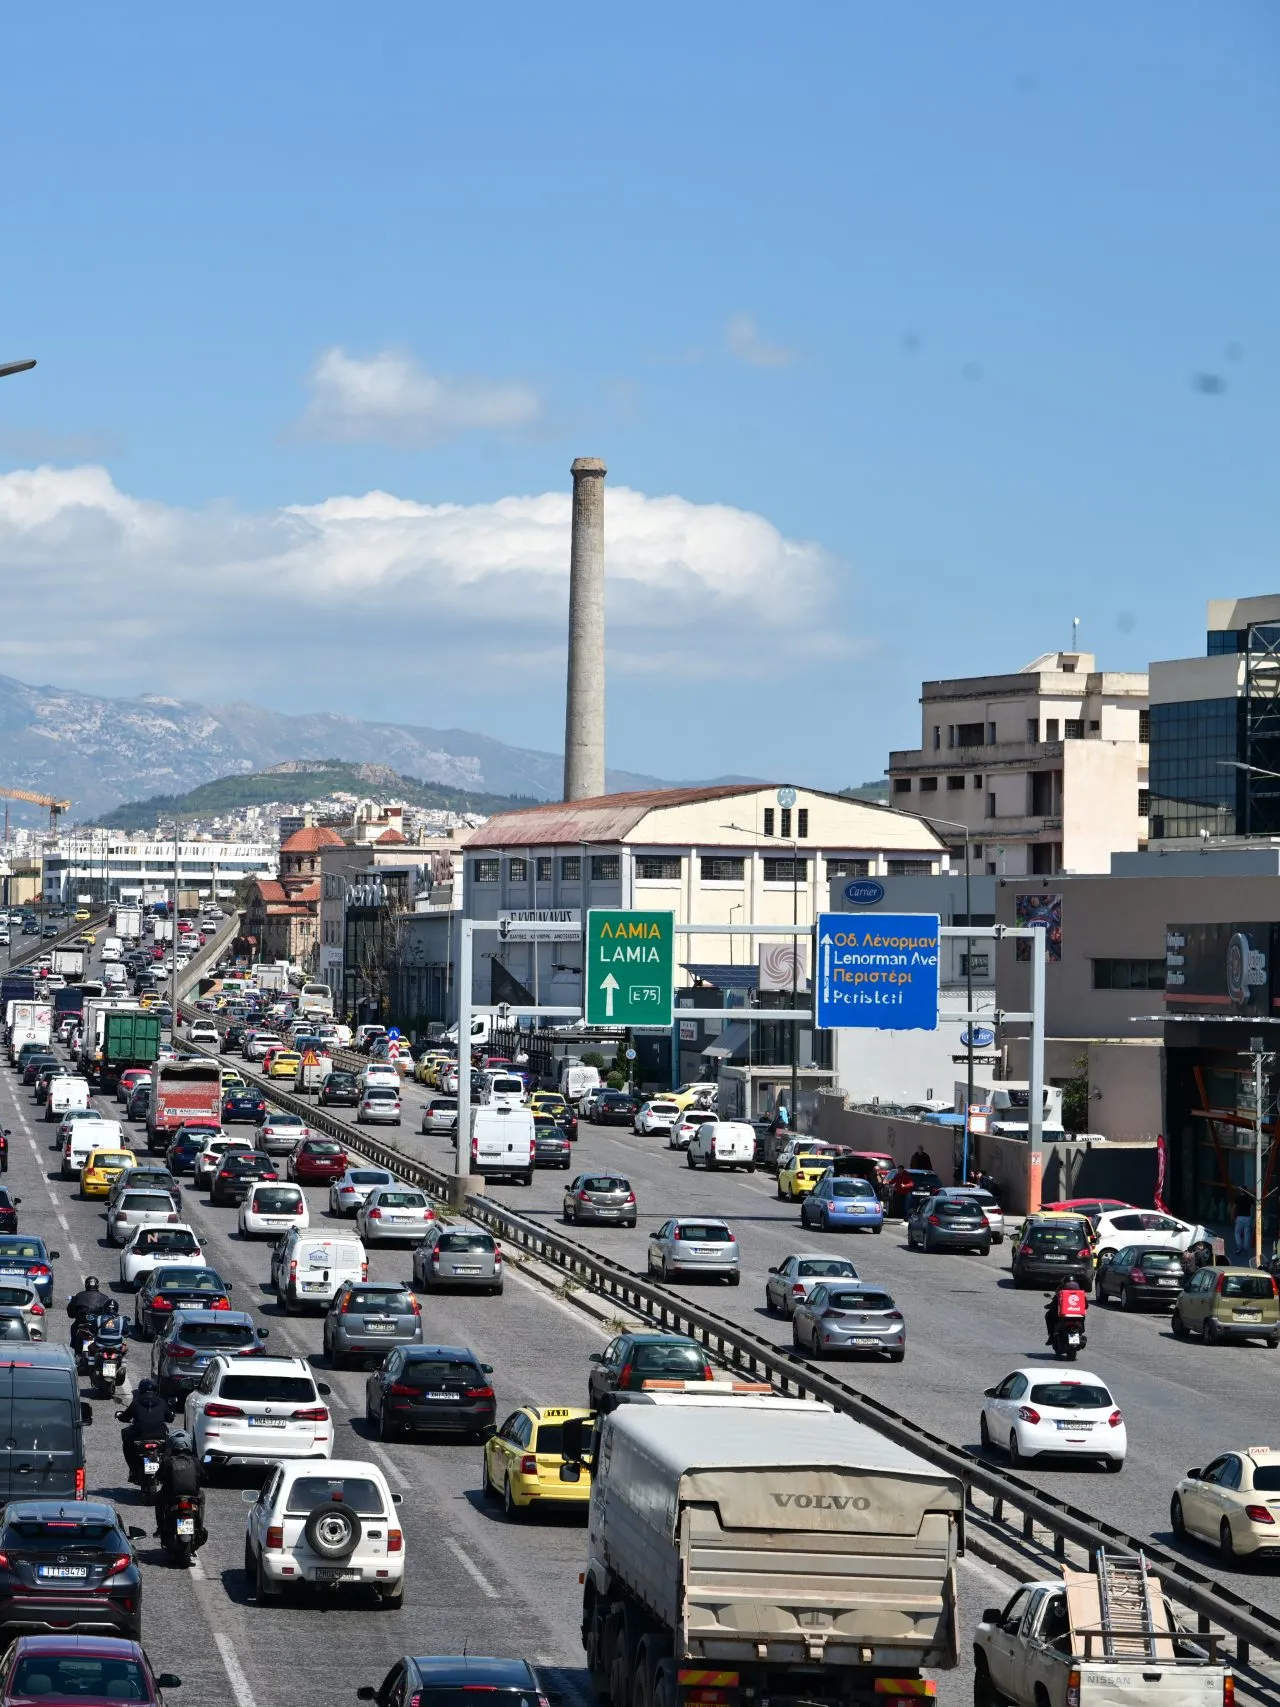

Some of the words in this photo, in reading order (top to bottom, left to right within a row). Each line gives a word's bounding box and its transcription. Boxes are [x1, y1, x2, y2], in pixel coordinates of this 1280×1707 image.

[849, 886, 878, 897] Carrier
[601, 922, 661, 939] ΛΑΜΙΑ
[601, 946, 660, 962] LAMIA
[834, 951, 907, 965] Lenorman
[834, 968, 912, 986] Περιστέρι
[769, 1492, 871, 1511] VOLVO
[1087, 1675, 1131, 1685] NISSAN
